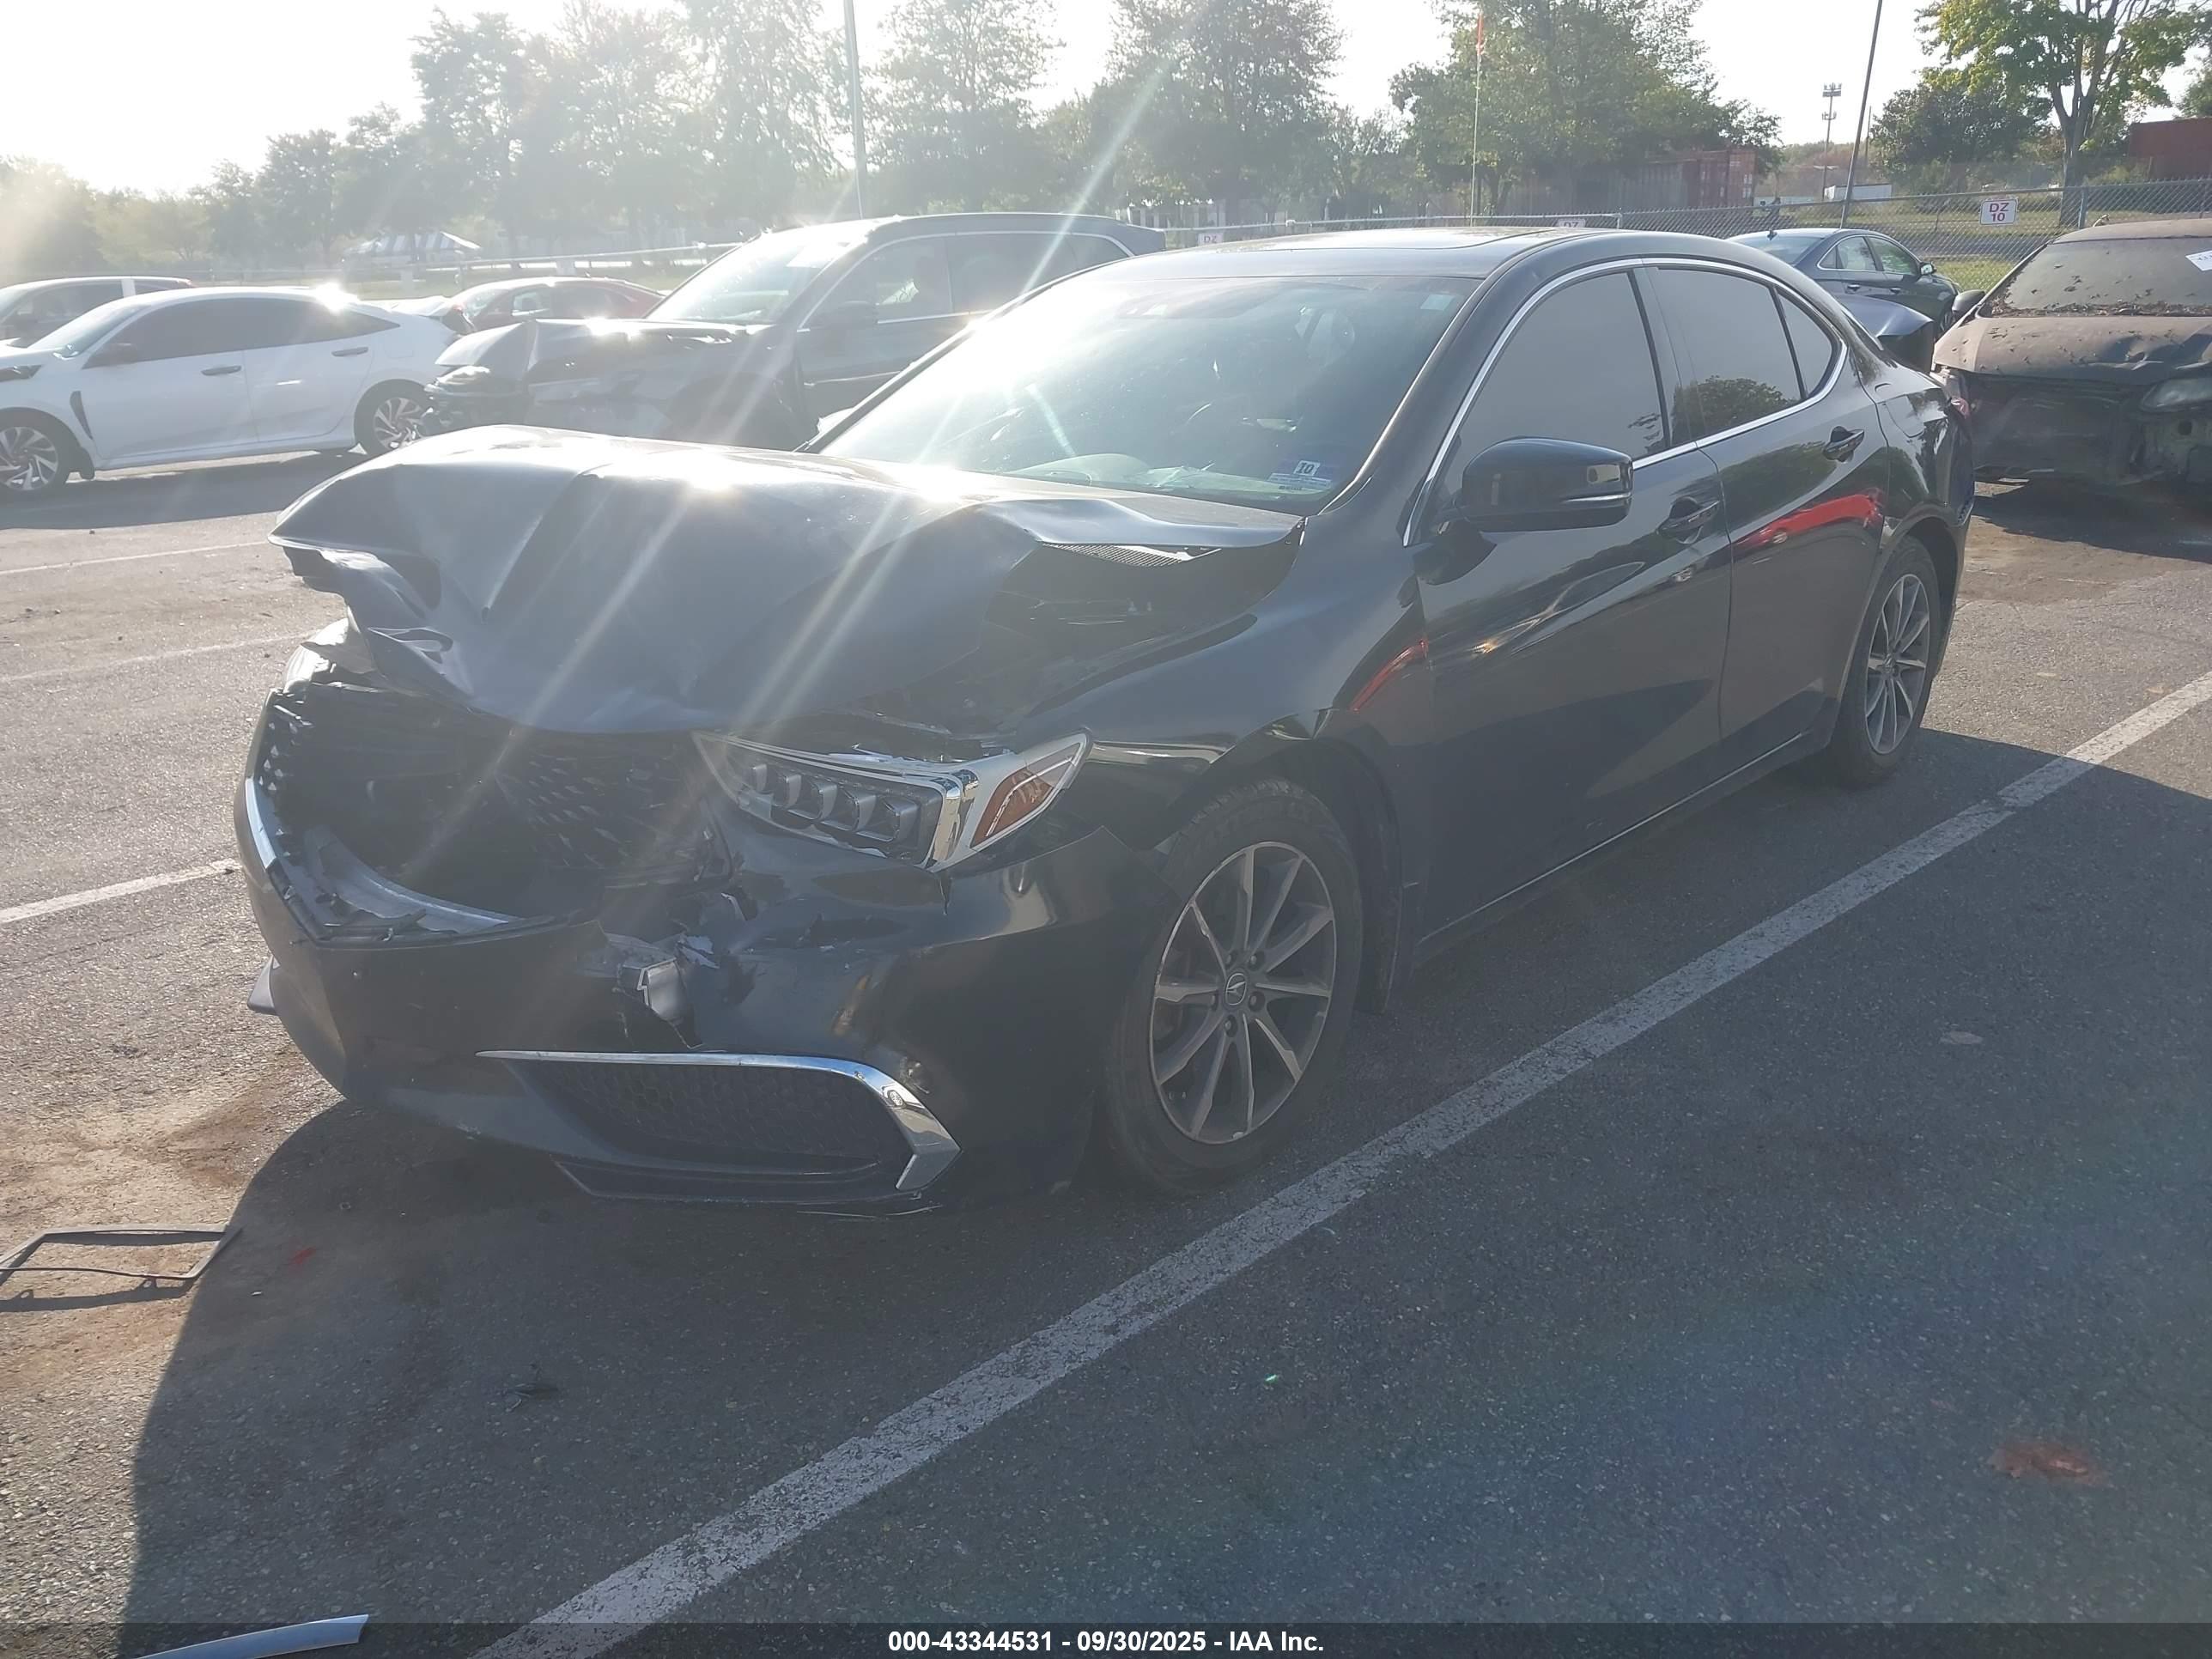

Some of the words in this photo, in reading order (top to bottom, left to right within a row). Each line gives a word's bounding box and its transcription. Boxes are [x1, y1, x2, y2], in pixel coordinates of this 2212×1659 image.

[1989, 202, 2010, 213] DZ
[1991, 212, 2006, 222] 10
[1295, 462, 1316, 474] 10
